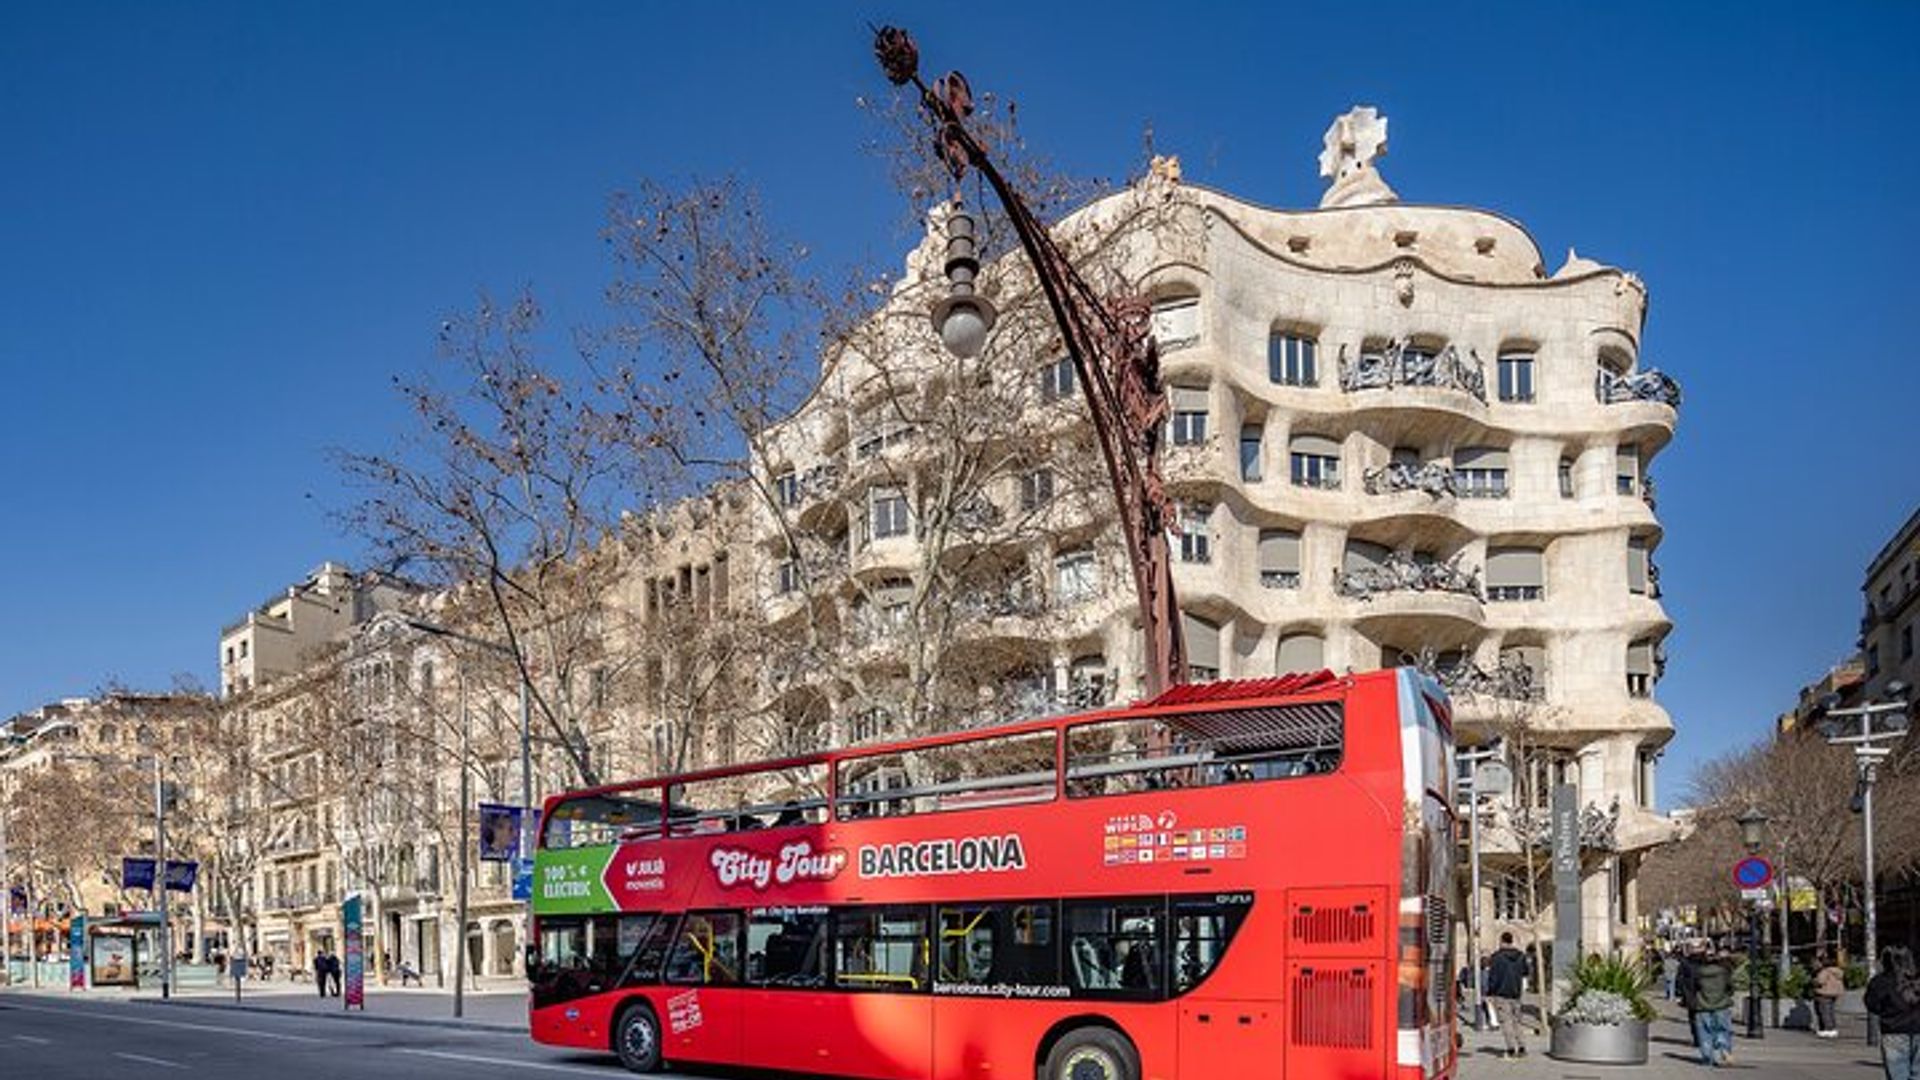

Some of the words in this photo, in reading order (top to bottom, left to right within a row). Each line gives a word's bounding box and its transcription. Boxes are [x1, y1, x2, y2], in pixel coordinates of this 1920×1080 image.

[711, 848, 772, 888] City
[776, 842, 845, 882] Tour
[859, 835, 1026, 877] BARCELONA
